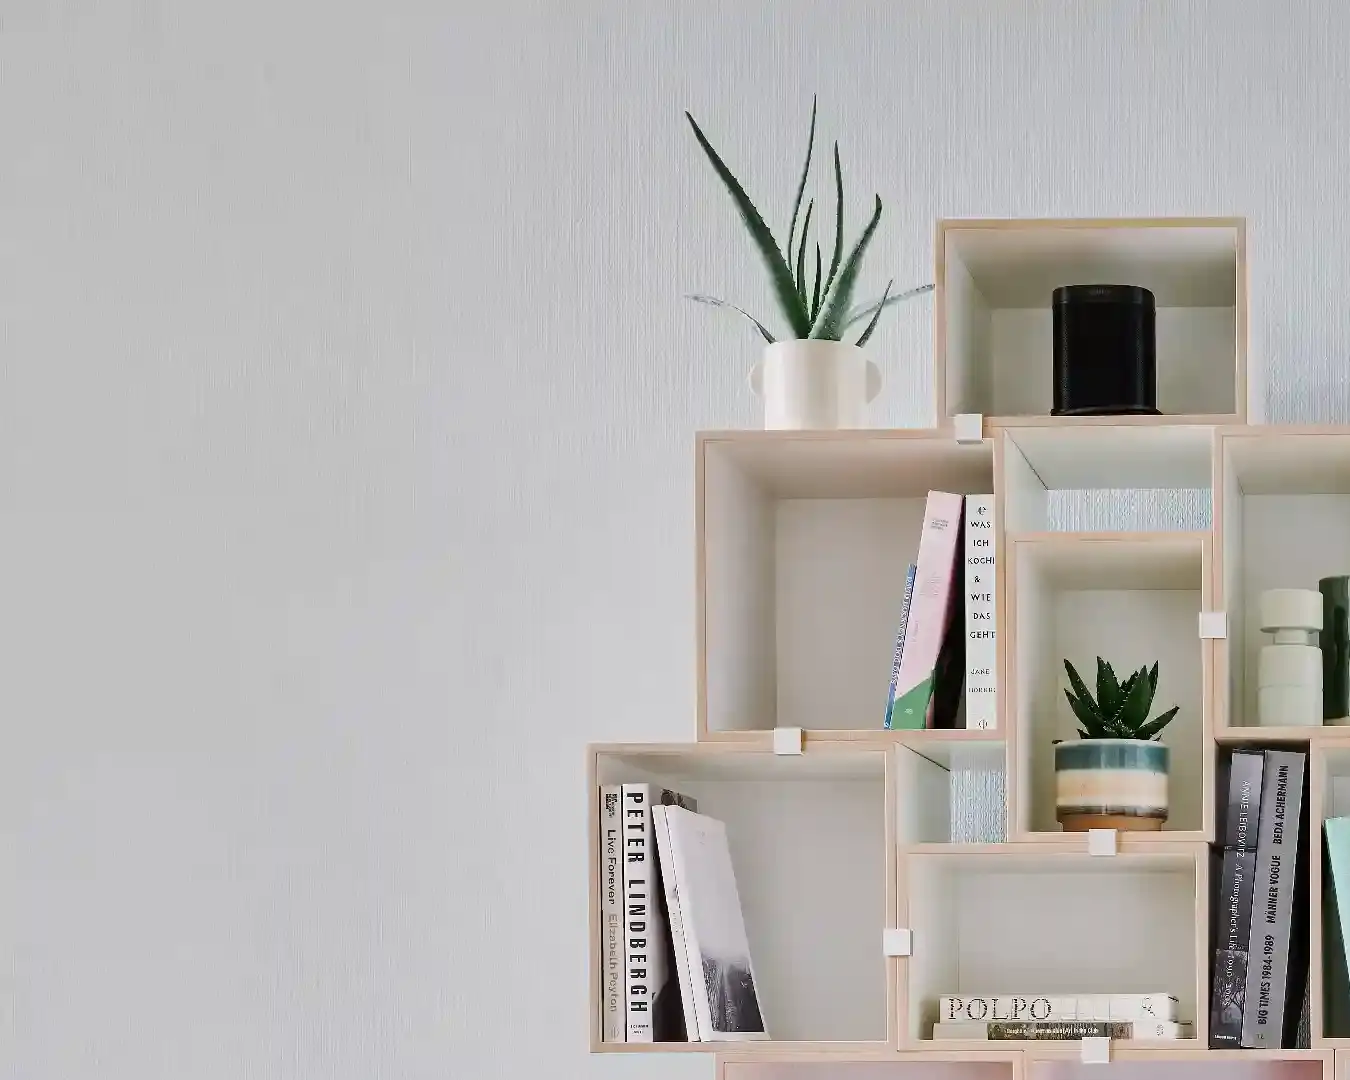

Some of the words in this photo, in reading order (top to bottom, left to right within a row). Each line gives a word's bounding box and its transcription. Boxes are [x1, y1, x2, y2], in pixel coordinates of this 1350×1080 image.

[970, 521, 991, 529] WAS
[973, 539, 989, 547] ICH
[970, 593, 992, 602] WIE
[973, 612, 991, 620] DAS
[1240, 780, 1250, 810] ANNIE
[1275, 765, 1289, 821] ACHERMANN
[607, 829, 617, 854] Live
[627, 792, 645, 863] PETER
[1236, 811, 1249, 858] LEIBOVITZ
[1273, 821, 1284, 846] BEDA
[607, 857, 617, 905] Forever
[1269, 855, 1281, 886] VOGUE
[1229, 872, 1244, 933] Photographer's
[1266, 886, 1279, 924] MÄNNER
[609, 913, 619, 970] Elizabeth
[628, 879, 648, 1013] LINDBERGH
[1228, 934, 1238, 950] Life
[1262, 934, 1275, 978] 1984-1989
[608, 972, 619, 1013] Peyton
[1259, 978, 1271, 1005] TIMES
[948, 997, 1052, 1021] POLPO
[1258, 1006, 1268, 1026] BIG
